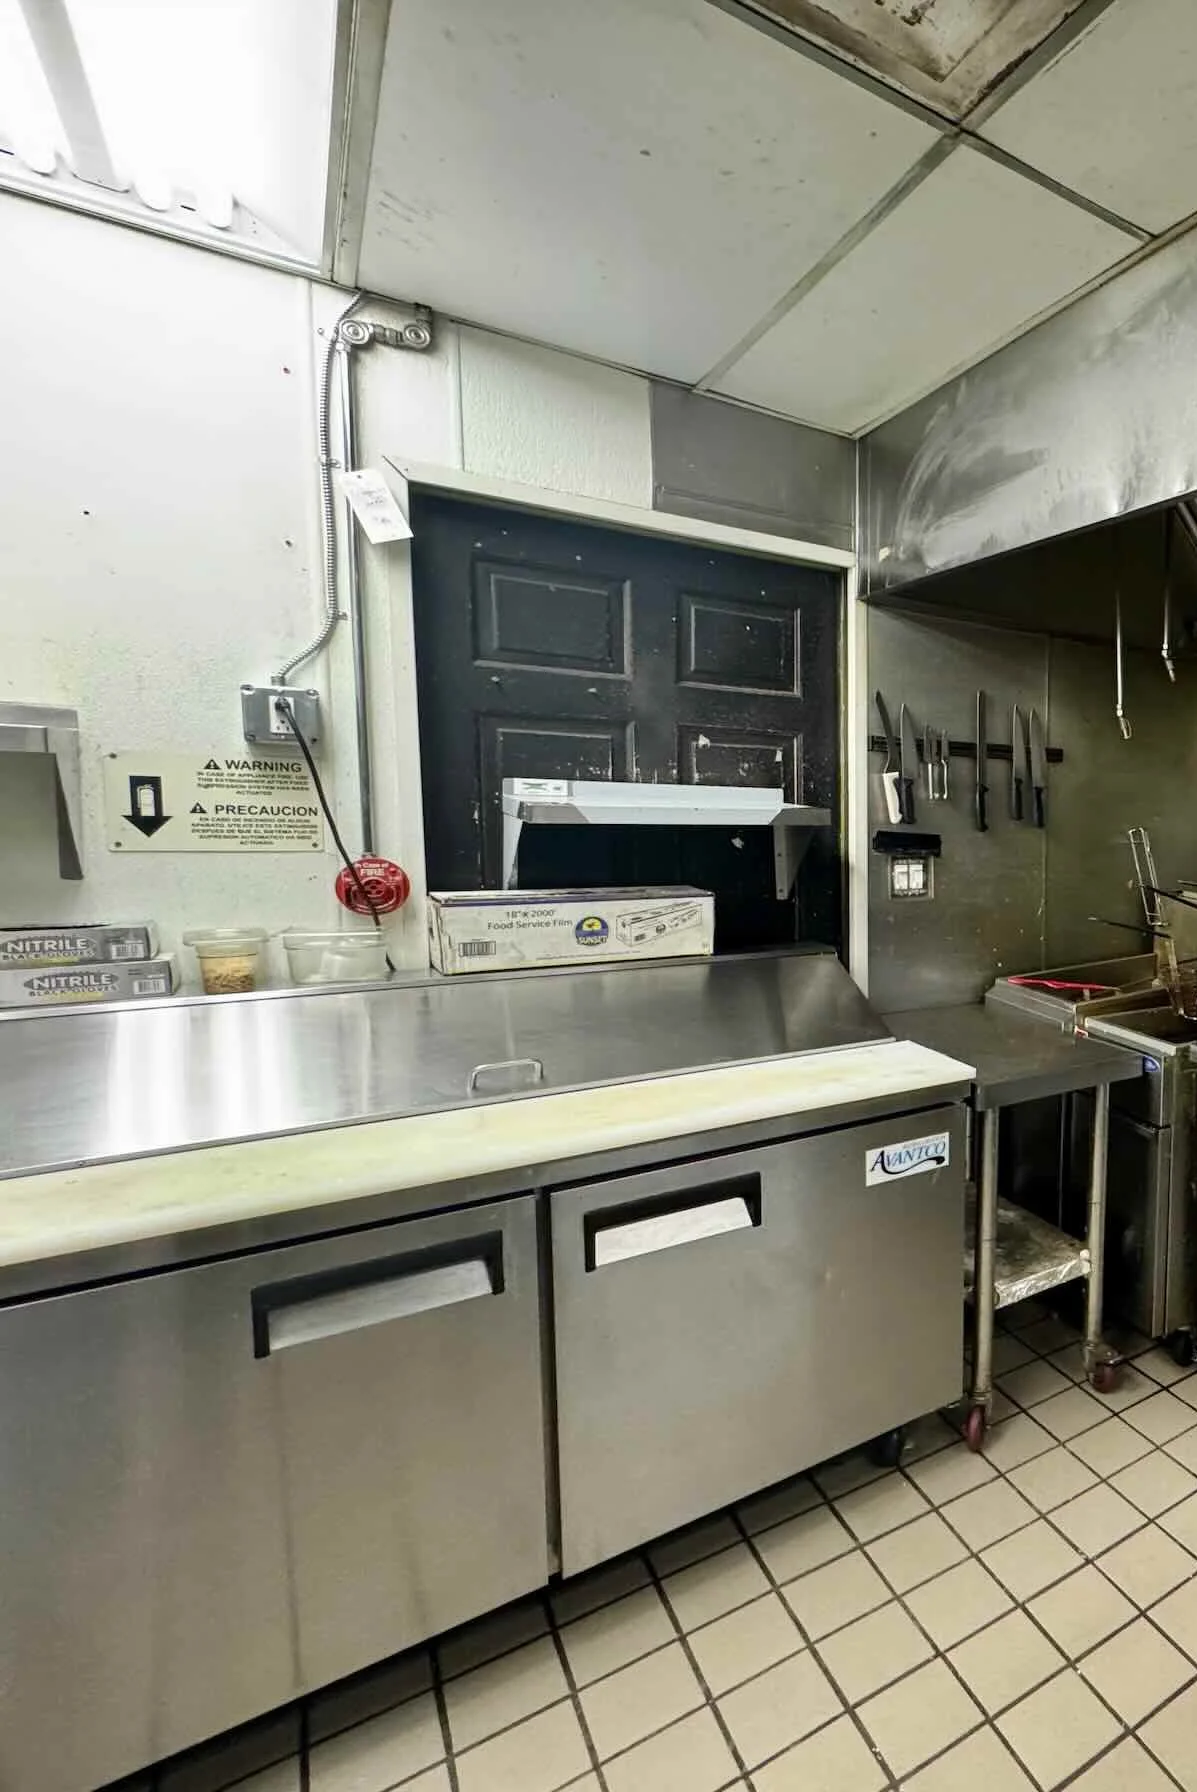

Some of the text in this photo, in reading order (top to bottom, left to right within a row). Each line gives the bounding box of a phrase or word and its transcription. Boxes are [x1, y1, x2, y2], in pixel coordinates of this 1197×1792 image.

[224, 760, 302, 772] WARNING
[215, 804, 318, 816] PRECAUCION
[361, 868, 385, 876] FIRE
[488, 918, 573, 930] Food Service Film
[7, 938, 88, 953] NITRILE
[32, 974, 112, 989] NITRILE
[870, 1141, 946, 1173] AVANTCO
